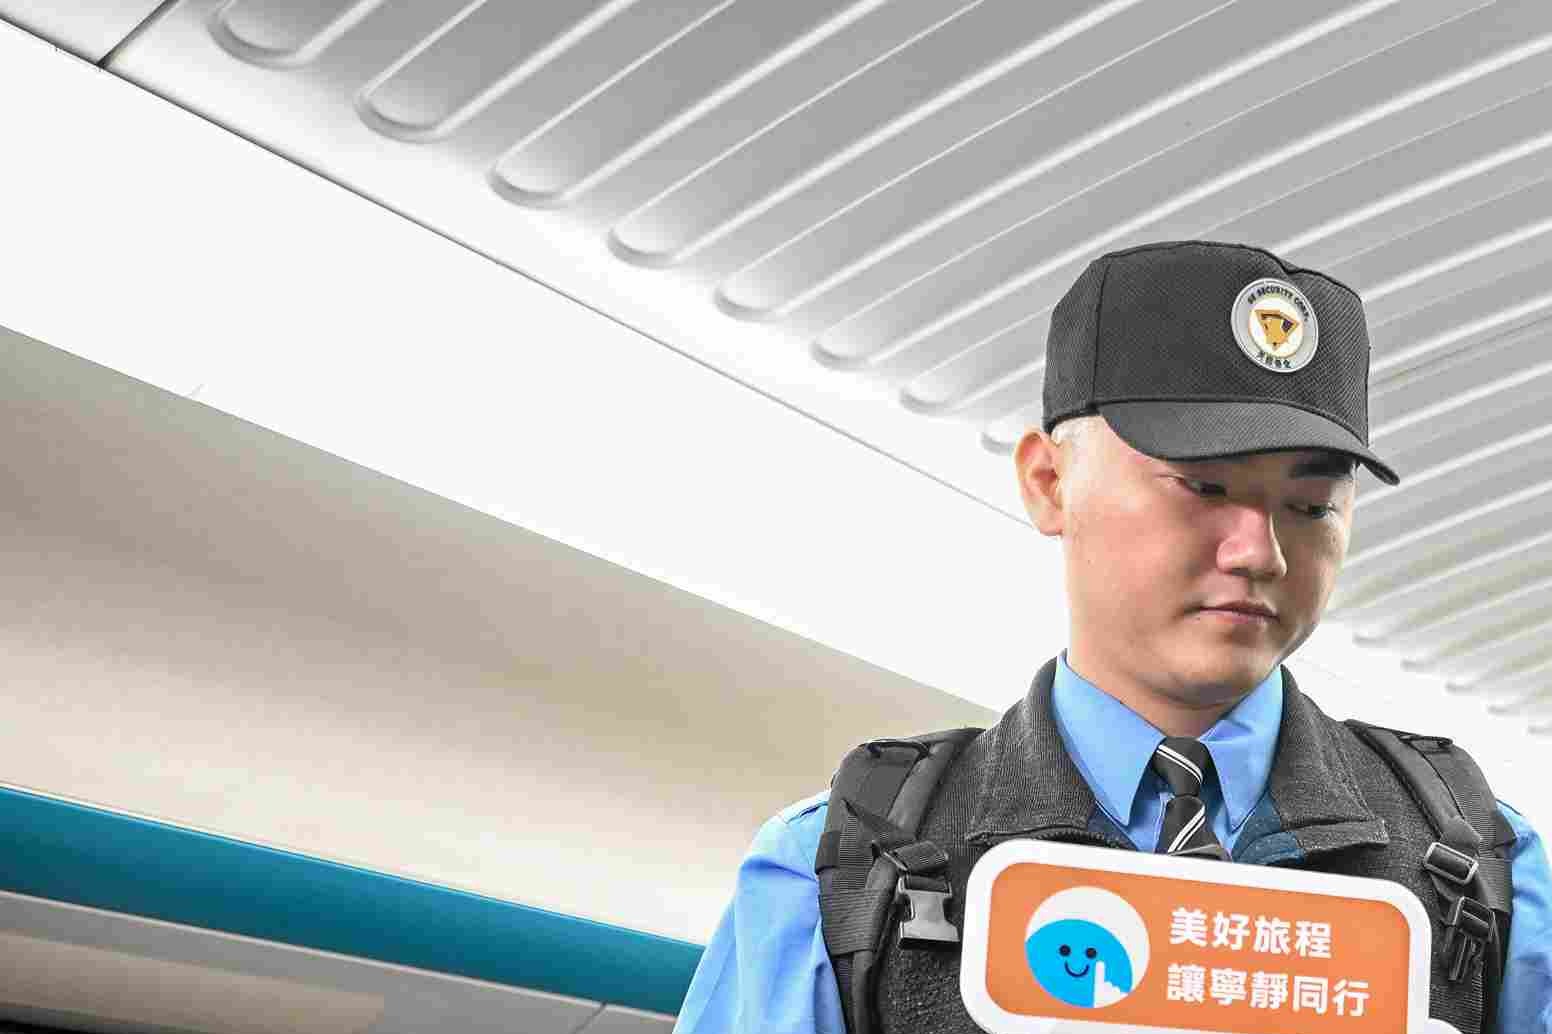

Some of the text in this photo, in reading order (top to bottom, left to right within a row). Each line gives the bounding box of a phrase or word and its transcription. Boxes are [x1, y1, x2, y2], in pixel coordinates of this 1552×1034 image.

[1168, 906, 1333, 960] 美好旅程
[1166, 962, 1371, 1017] 讓寧靜同行
